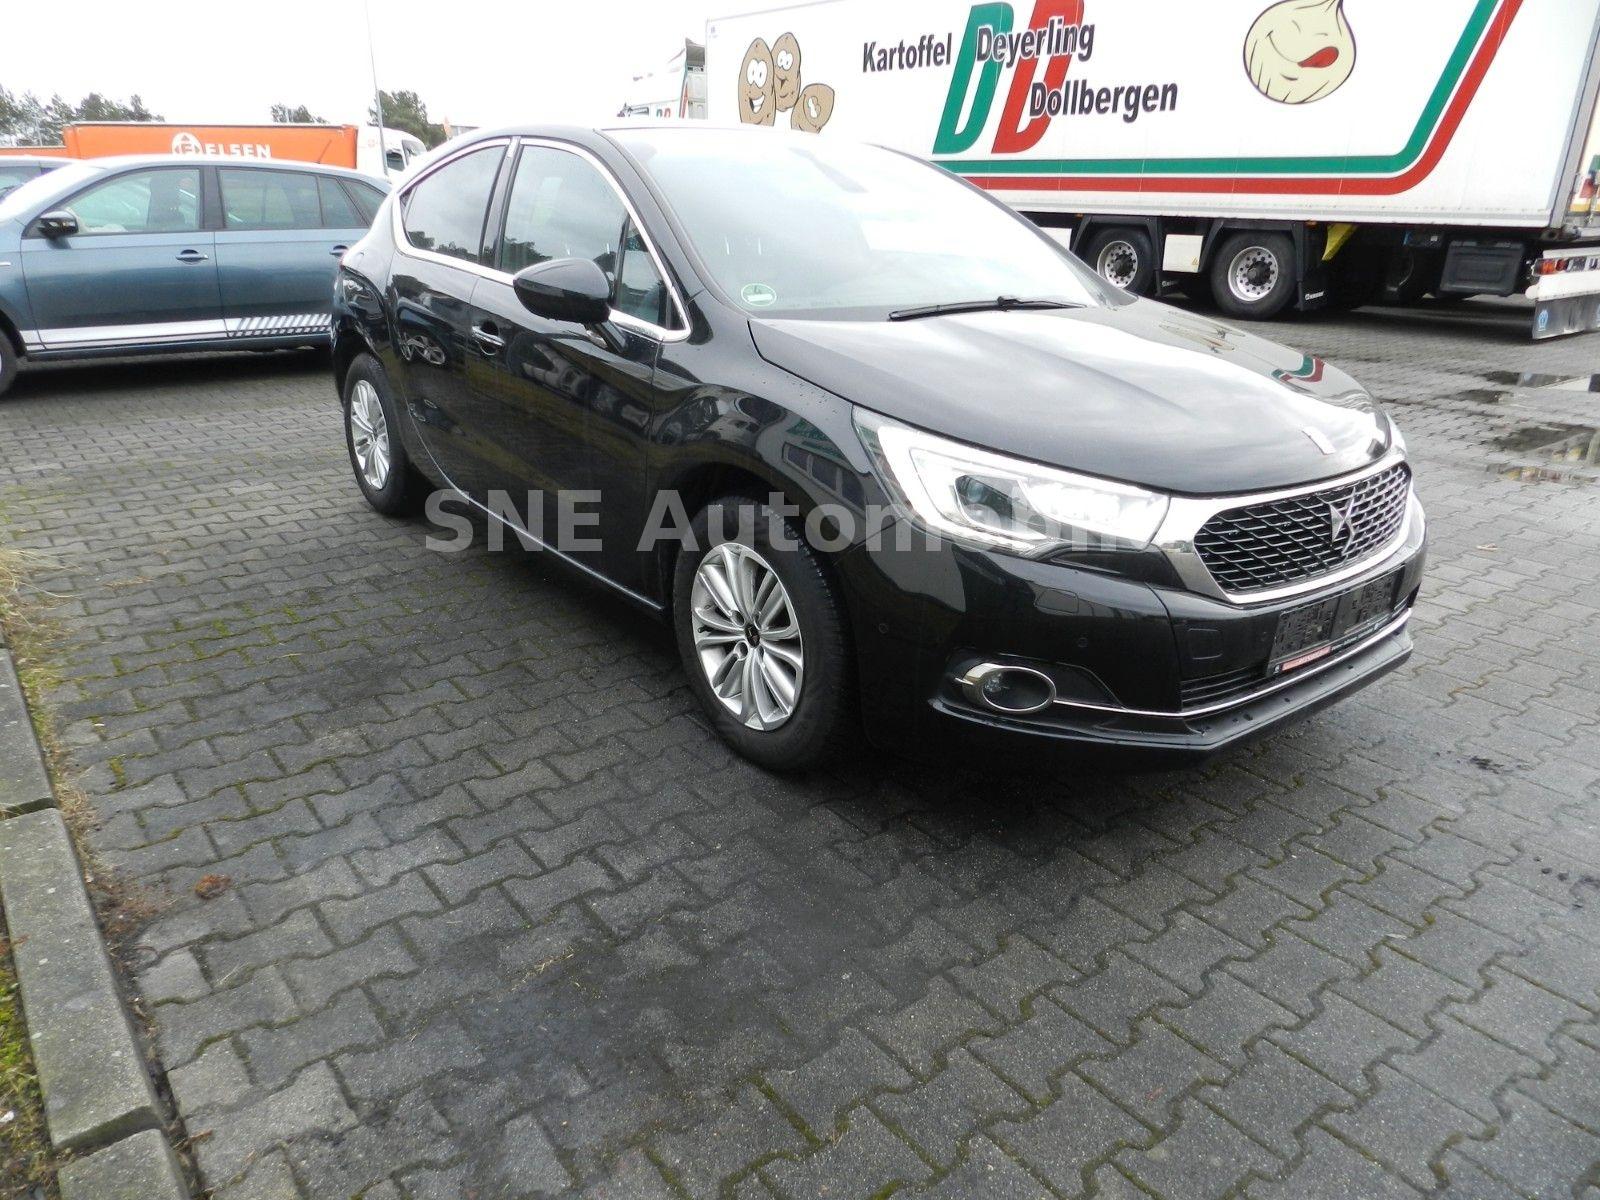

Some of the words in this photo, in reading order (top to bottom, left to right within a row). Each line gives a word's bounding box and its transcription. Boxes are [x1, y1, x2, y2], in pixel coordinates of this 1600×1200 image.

[863, 33, 952, 73] Kartoffel
[976, 18, 1096, 68] Deyerling
[1029, 79, 1178, 123] Dollbergen
[205, 143, 271, 158] ELSEN
